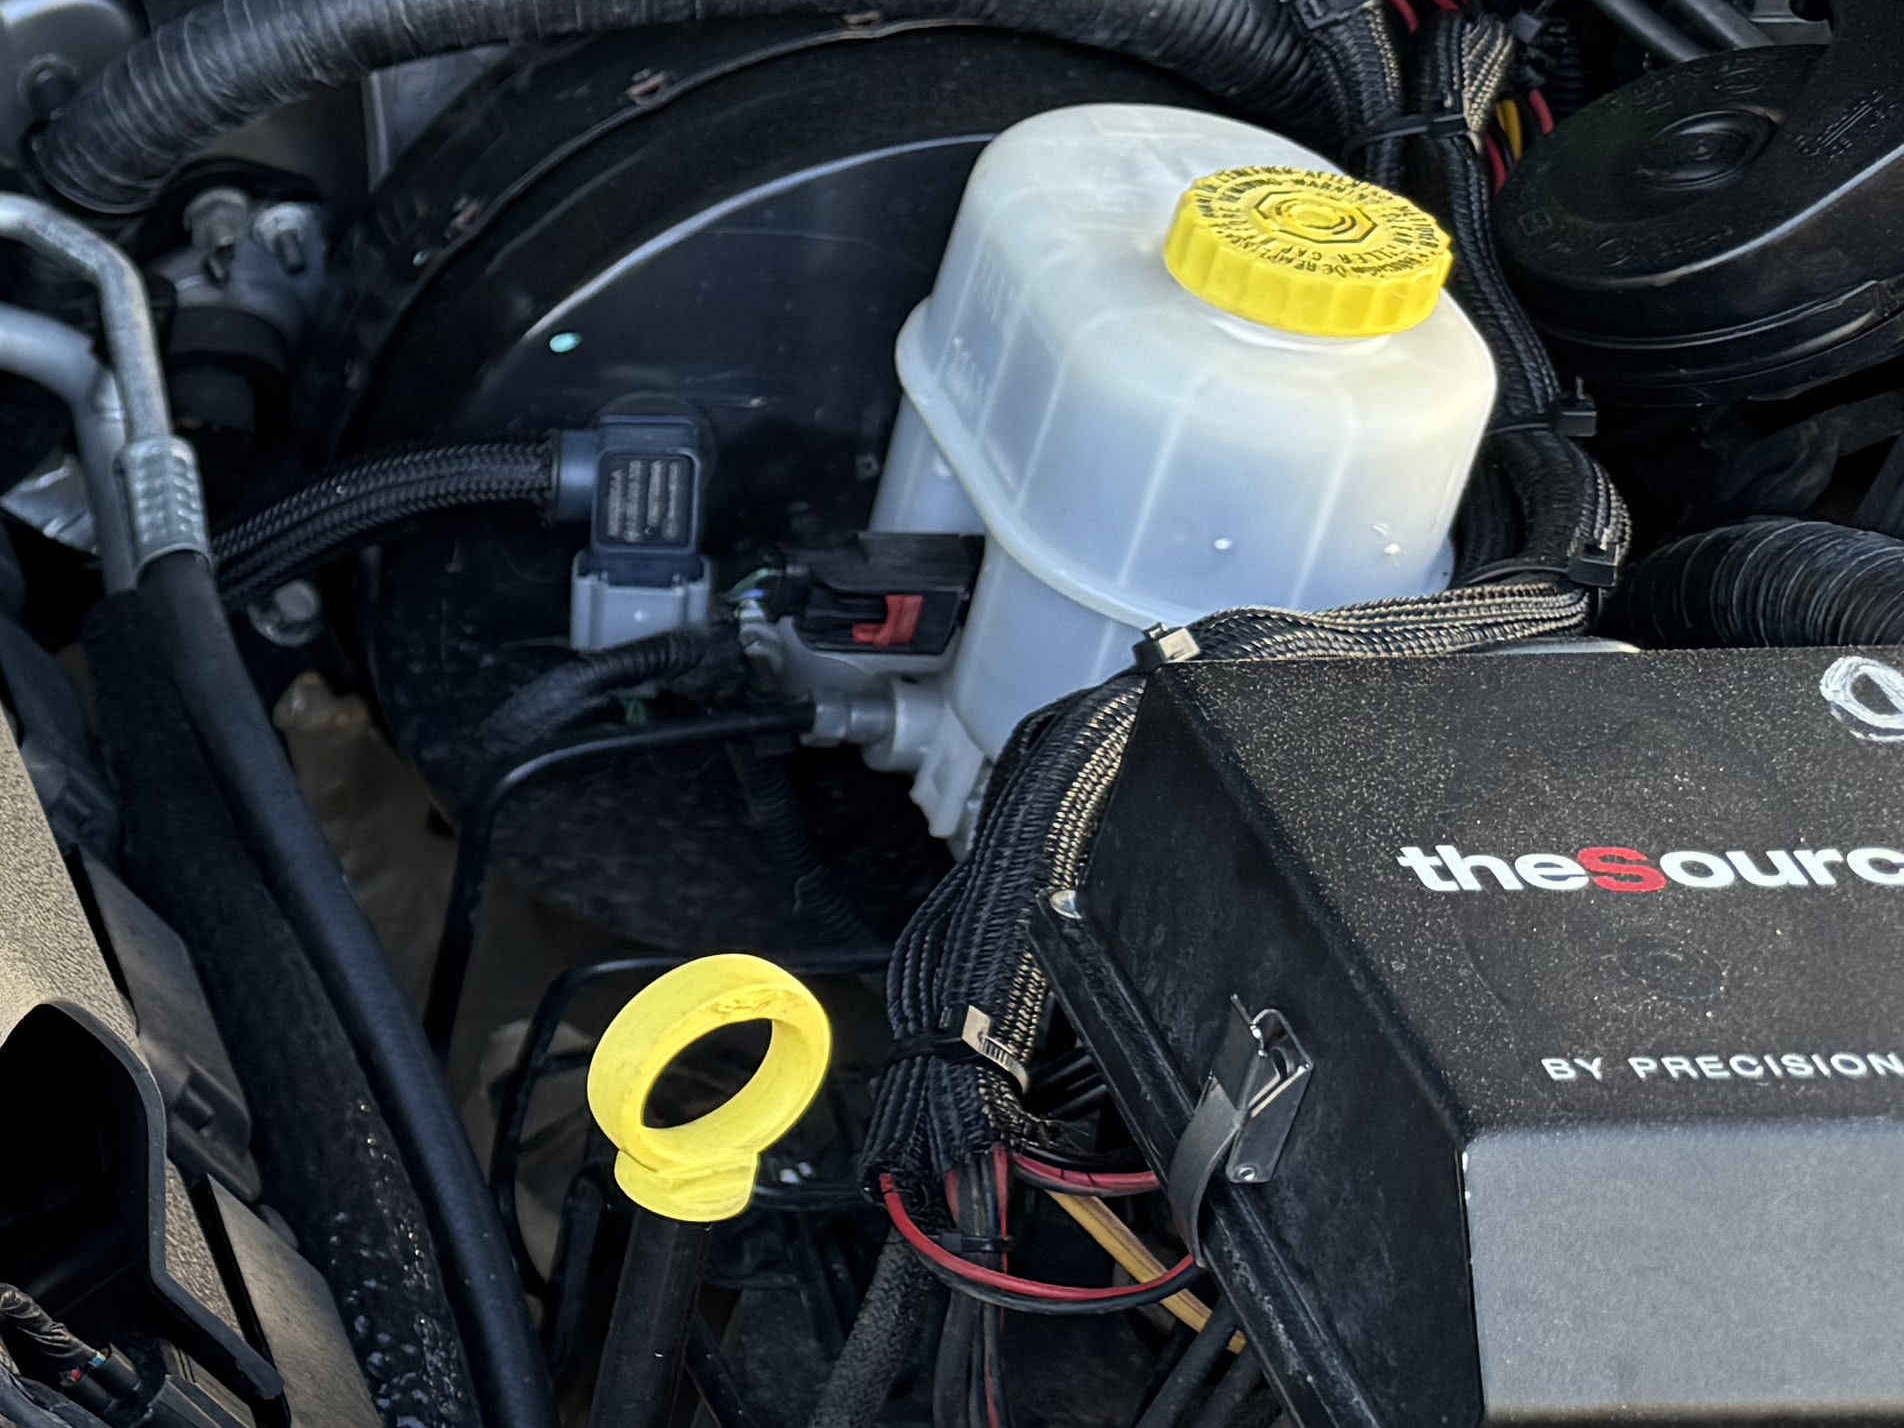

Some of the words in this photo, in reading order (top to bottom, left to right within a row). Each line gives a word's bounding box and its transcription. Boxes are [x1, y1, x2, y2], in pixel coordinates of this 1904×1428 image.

[1281, 245, 1323, 262] CAP
[1396, 843, 1904, 893] theSourc
[1540, 1057, 1605, 1082] BY
[1627, 1051, 1904, 1081] PRECISION
